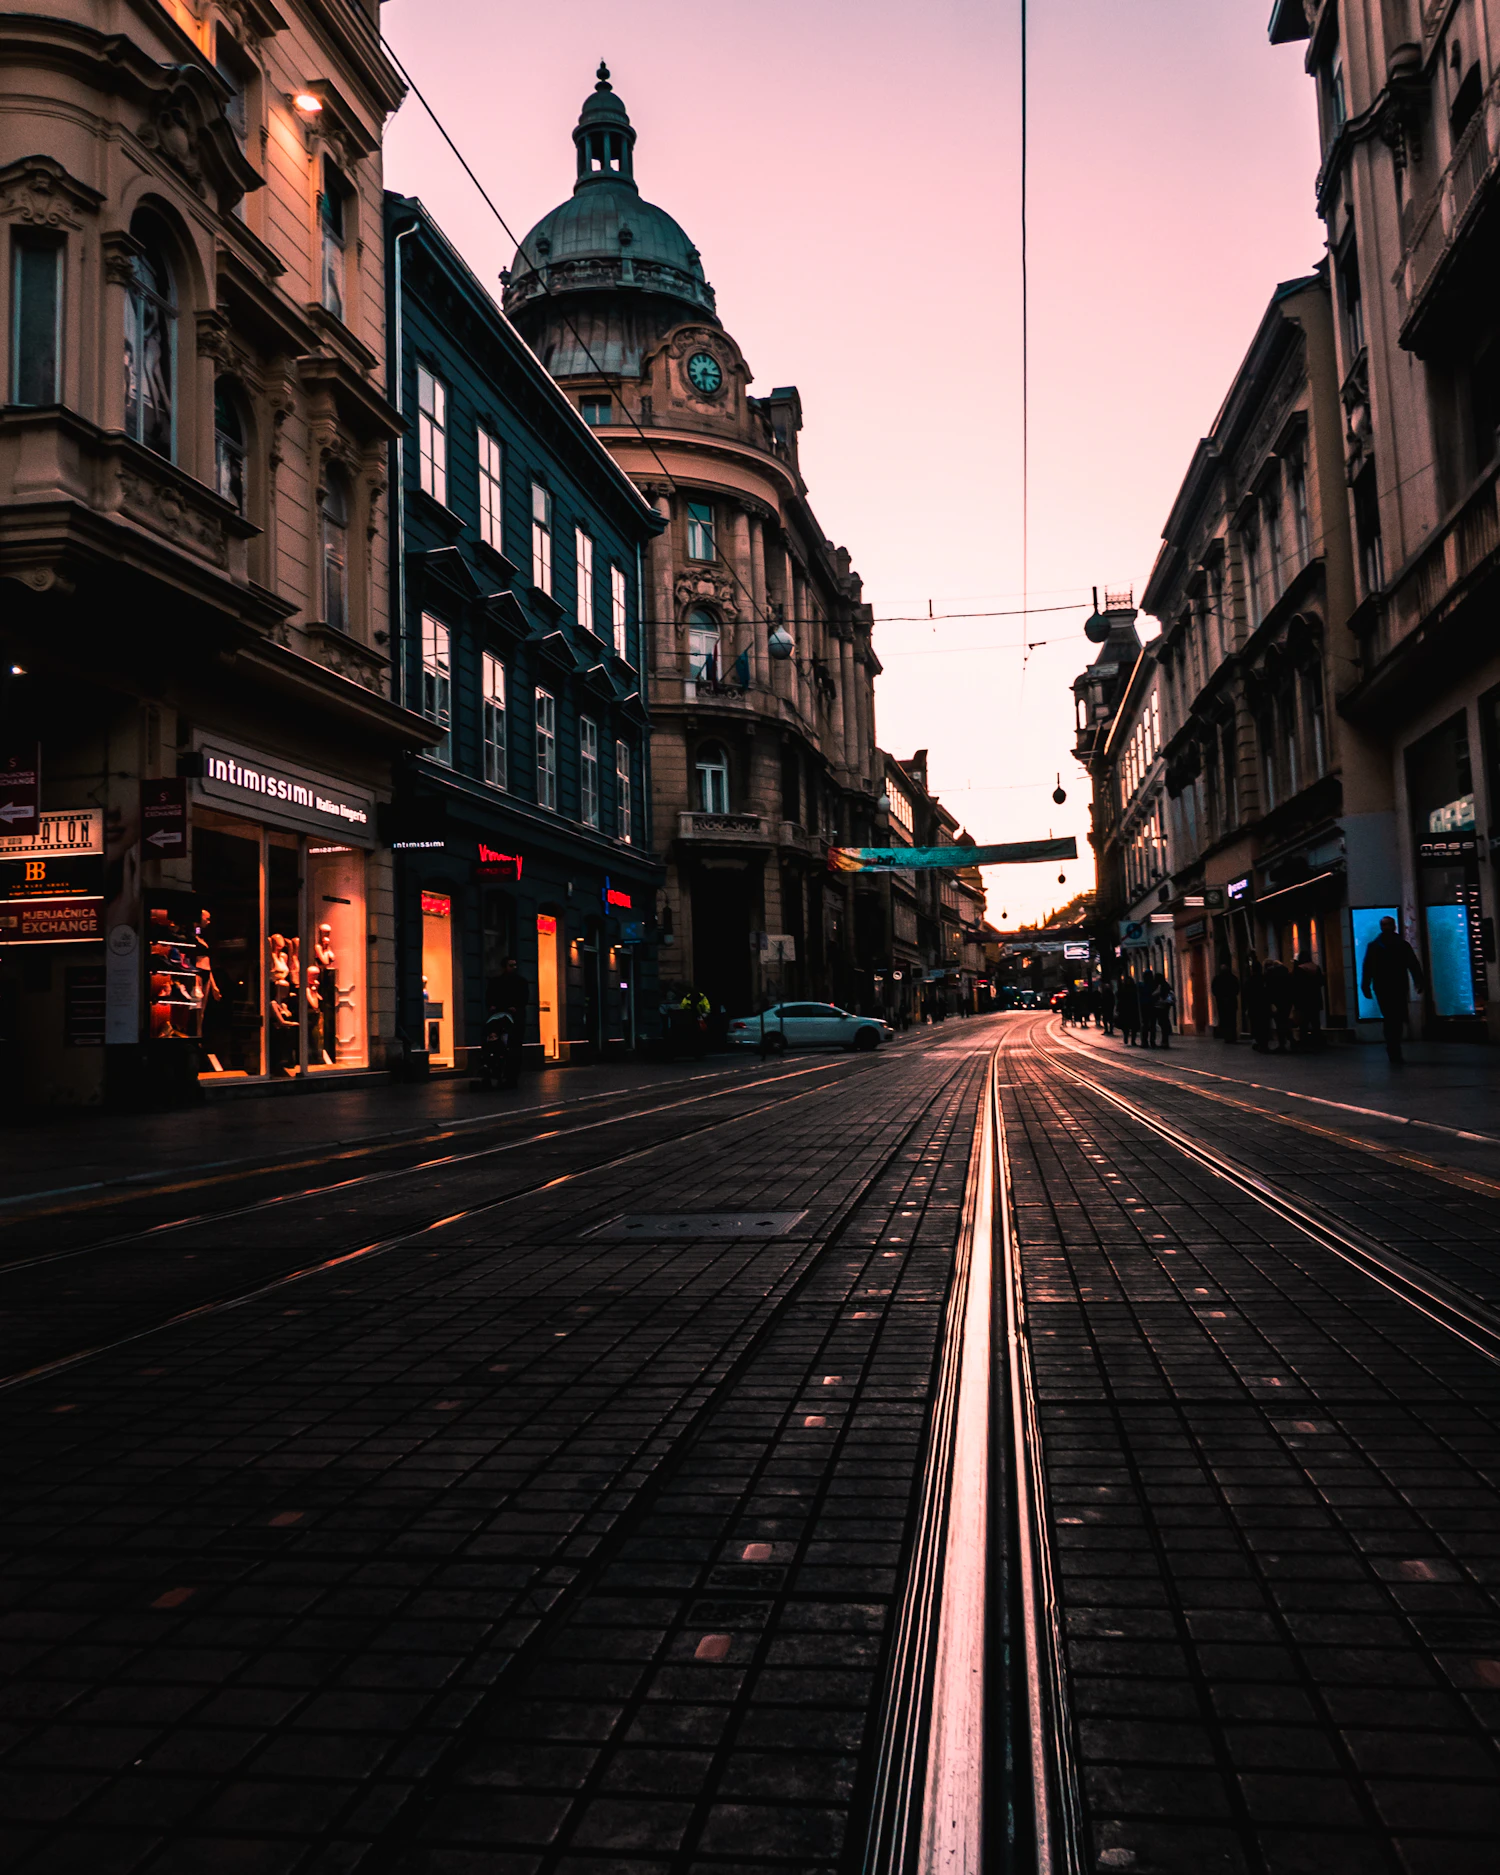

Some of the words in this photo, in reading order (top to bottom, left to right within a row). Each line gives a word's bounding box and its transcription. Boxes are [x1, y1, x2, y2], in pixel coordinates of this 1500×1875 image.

[208, 757, 315, 808] intimissimi
[316, 796, 340, 815] Italian
[340, 804, 367, 823] lingerie
[393, 841, 445, 849] intimissimi
[1419, 841, 1475, 851] MASS
[22, 907, 98, 921] MJENJAČNICA
[21, 919, 98, 934] EXCHANGE
